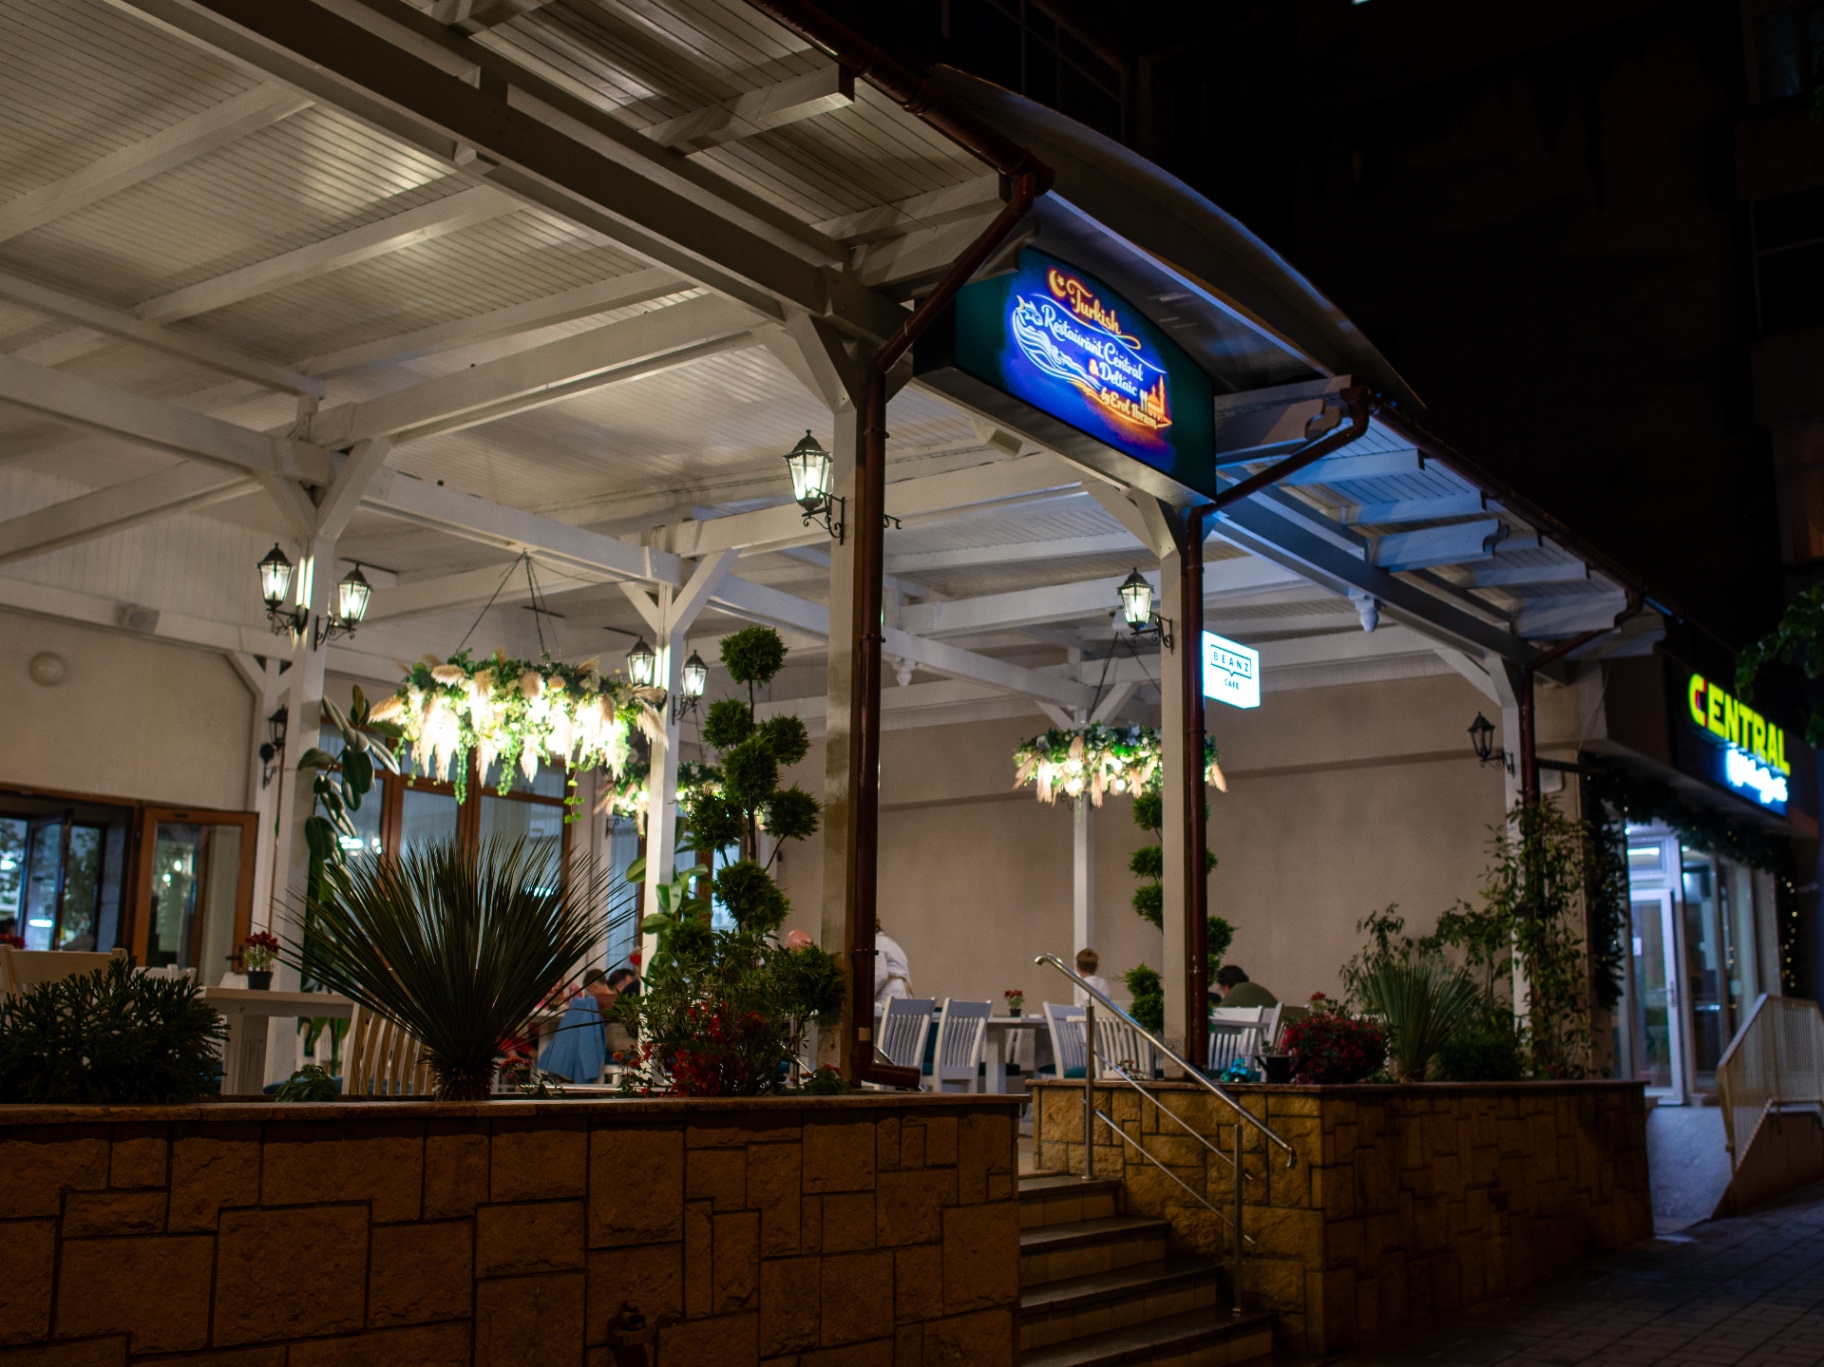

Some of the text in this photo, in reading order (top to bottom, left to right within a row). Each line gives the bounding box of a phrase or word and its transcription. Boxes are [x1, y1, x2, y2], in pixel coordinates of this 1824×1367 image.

[1066, 279, 1122, 335] Turkish
[1041, 304, 1144, 382] Restaurant Central
[1099, 362, 1138, 396] Deltaic
[1100, 386, 1110, 406] by
[1110, 391, 1130, 415] Erol
[1213, 651, 1249, 673] BEANZ
[1224, 679, 1240, 690] CAFE
[1687, 673, 1791, 777] CENTRAL
